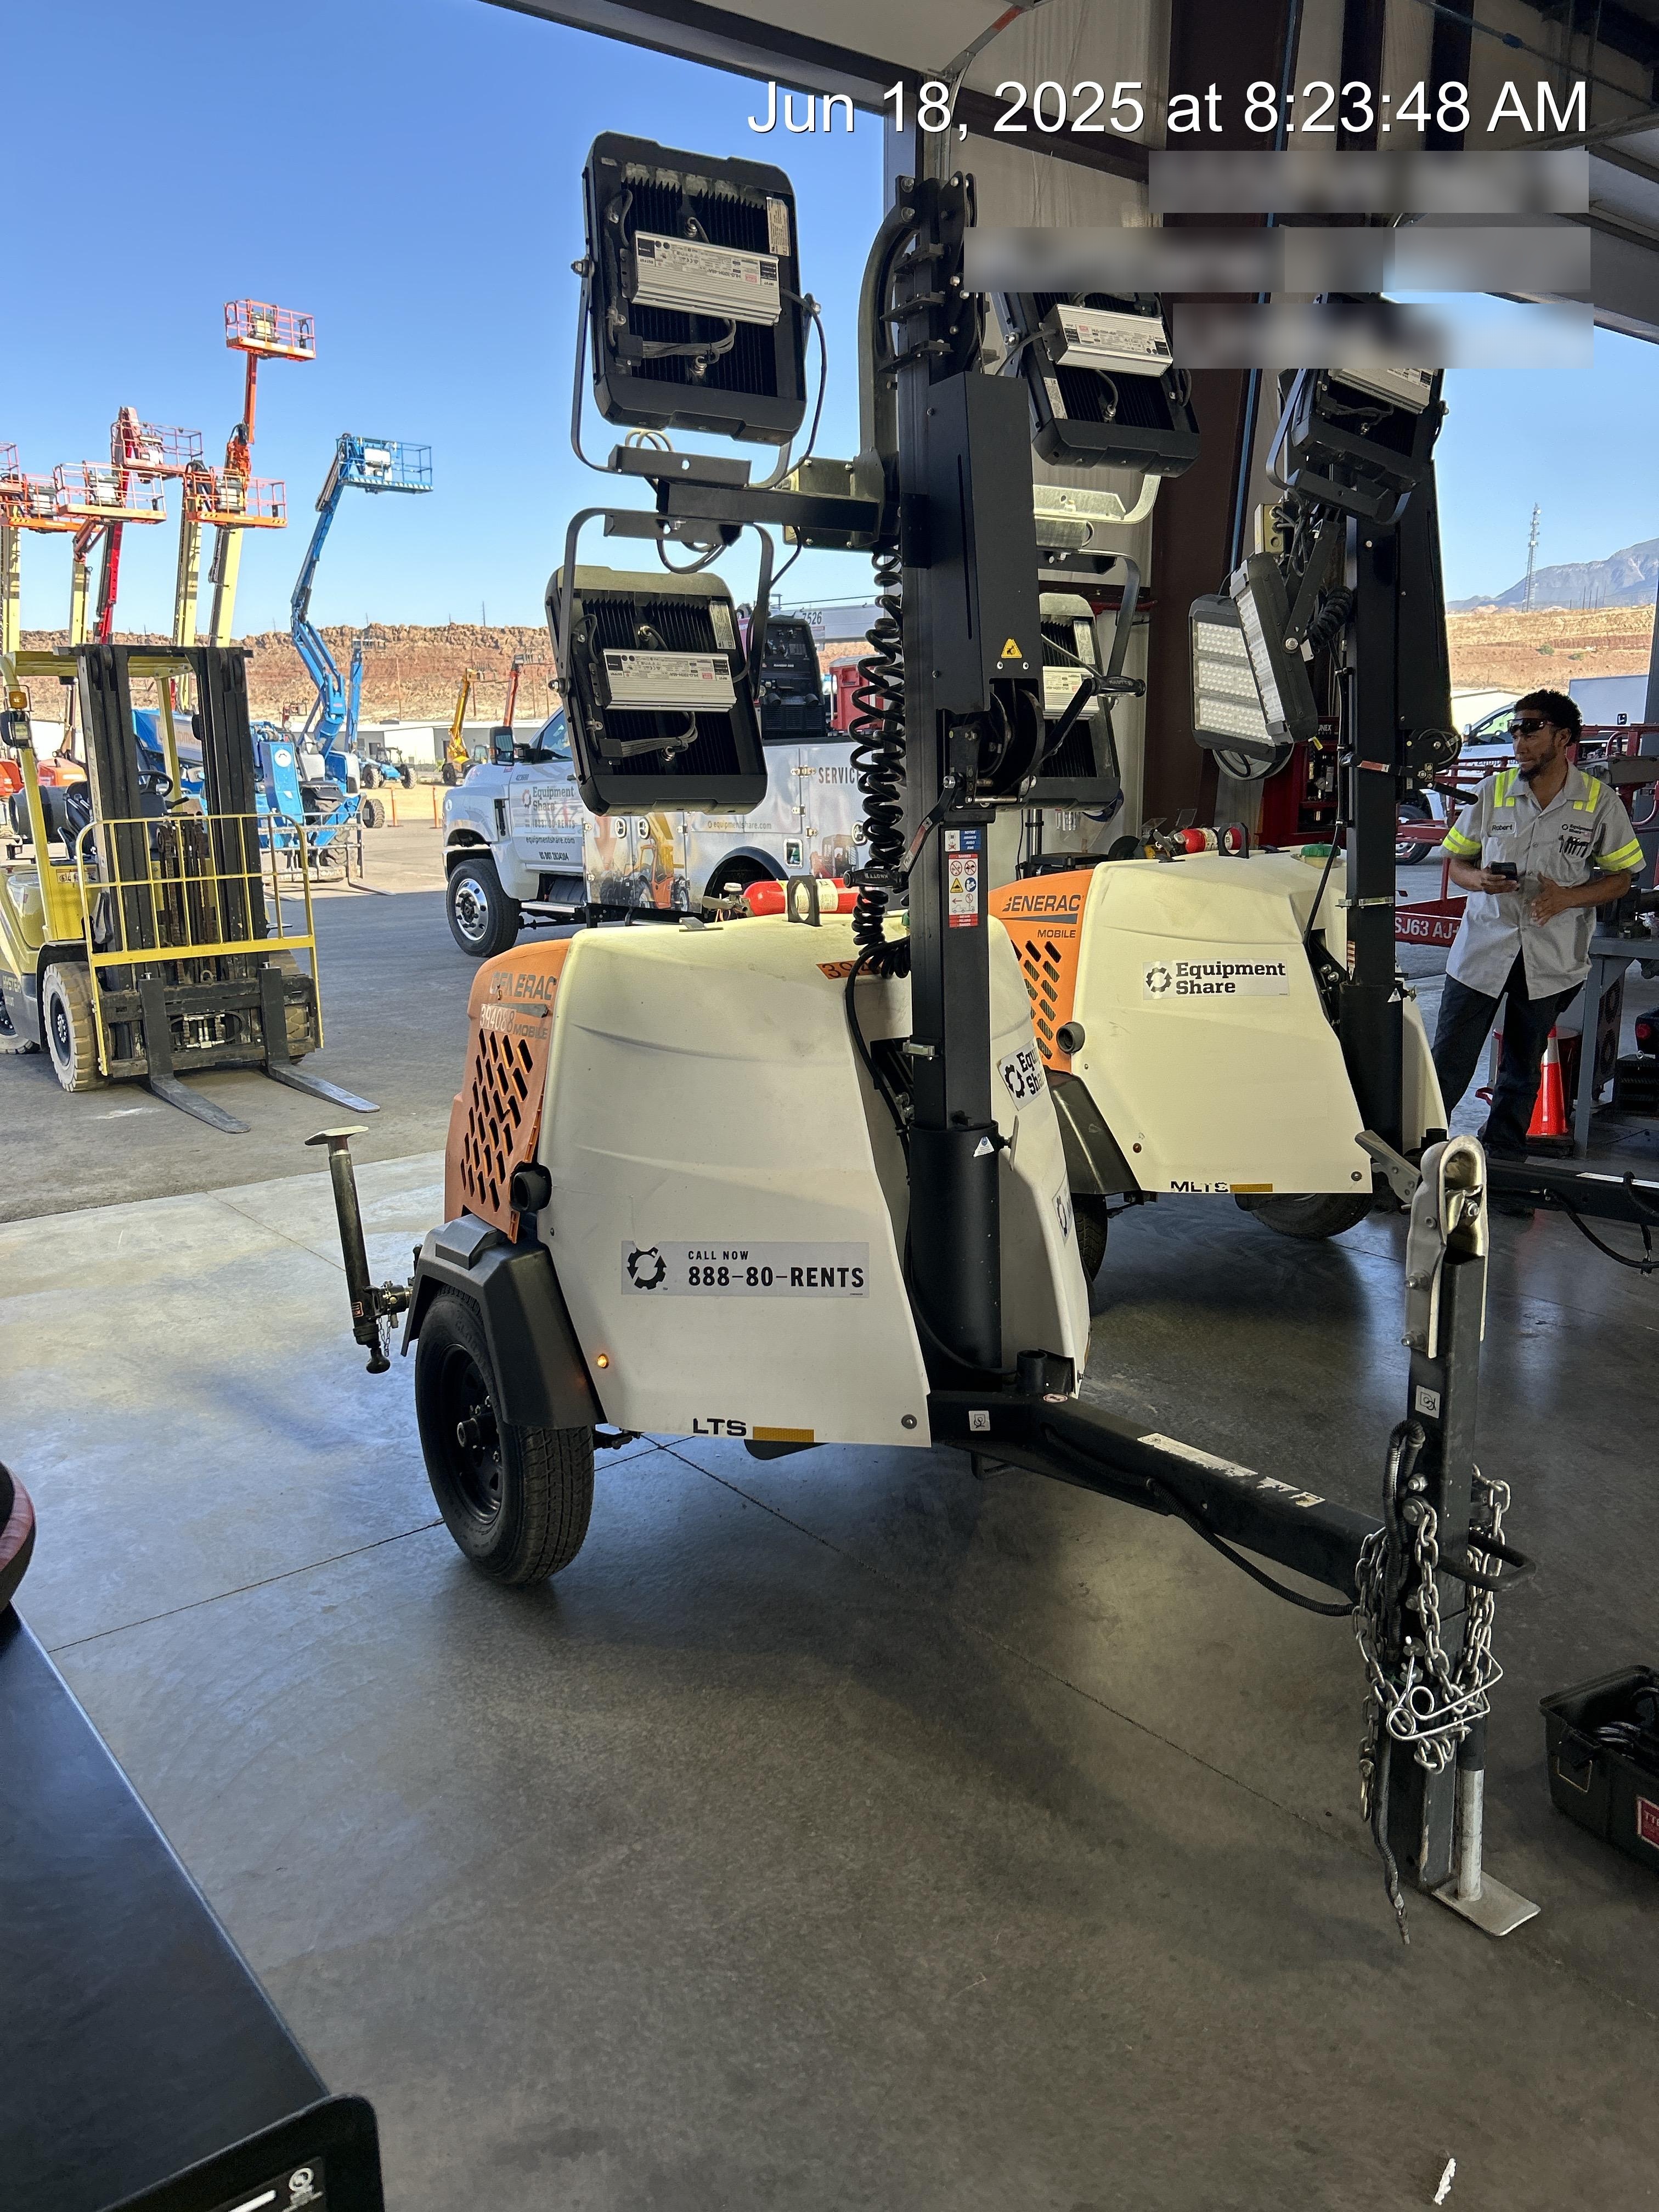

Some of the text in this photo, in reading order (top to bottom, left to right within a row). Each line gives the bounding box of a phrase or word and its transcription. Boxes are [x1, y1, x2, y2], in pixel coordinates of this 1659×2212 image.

[802, 611, 822, 625] 7526
[532, 786, 574, 799] Equipment
[533, 800, 555, 811] Share
[714, 820, 772, 830] equipmentshare.com
[526, 836, 575, 844] equipmentshare.com
[1395, 917, 1430, 936] SJ63
[1037, 929, 1076, 938] MOBILE
[1176, 961, 1286, 979] Equipment
[1176, 980, 1237, 995] Share
[688, 1250, 749, 1260] CALL NOW
[688, 1266, 864, 1288] 888-80-RENTS
[693, 1418, 747, 1436] LTS
